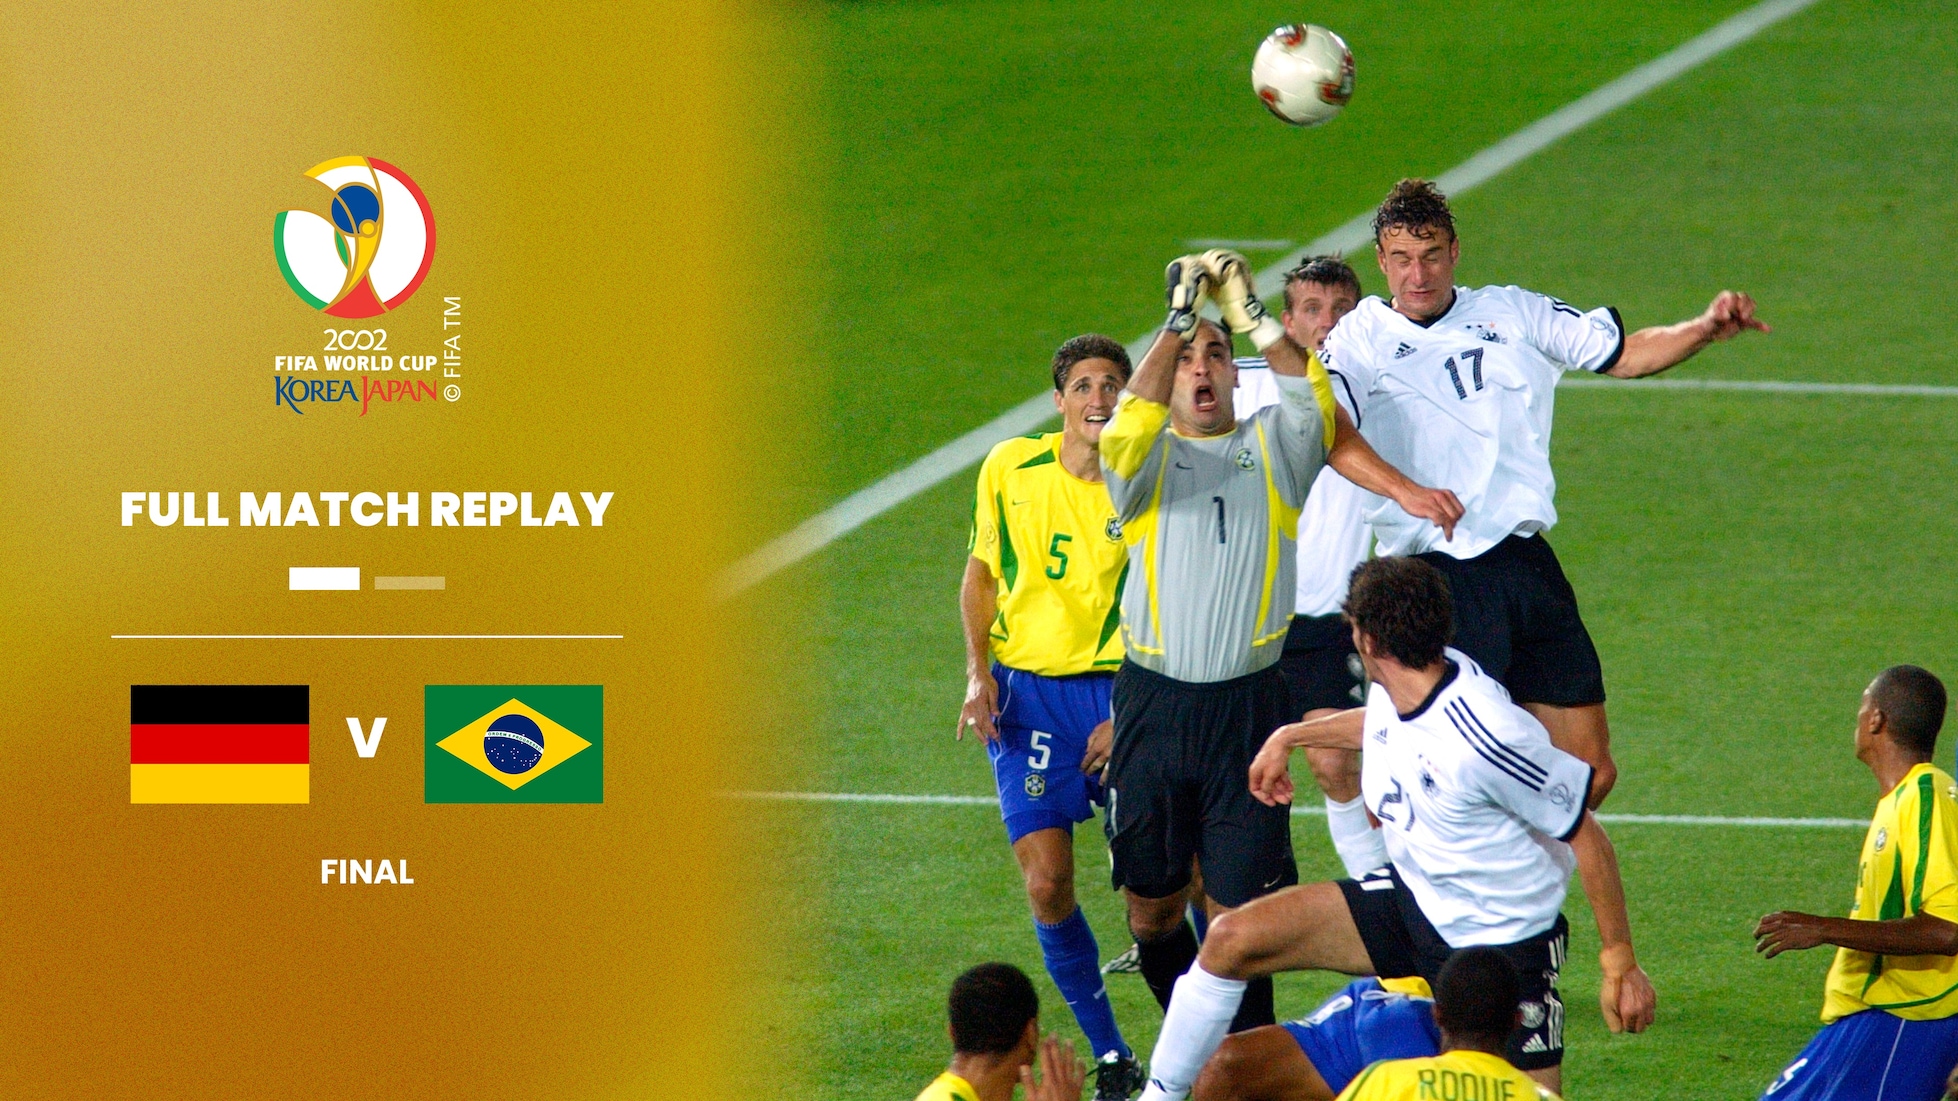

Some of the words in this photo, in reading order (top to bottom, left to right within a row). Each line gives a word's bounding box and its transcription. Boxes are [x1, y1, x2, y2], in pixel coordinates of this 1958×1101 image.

[1444, 347, 1484, 400] 17
[1212, 495, 1227, 544] 1
[1045, 532, 1073, 580] 5
[1027, 730, 1052, 770] 5
